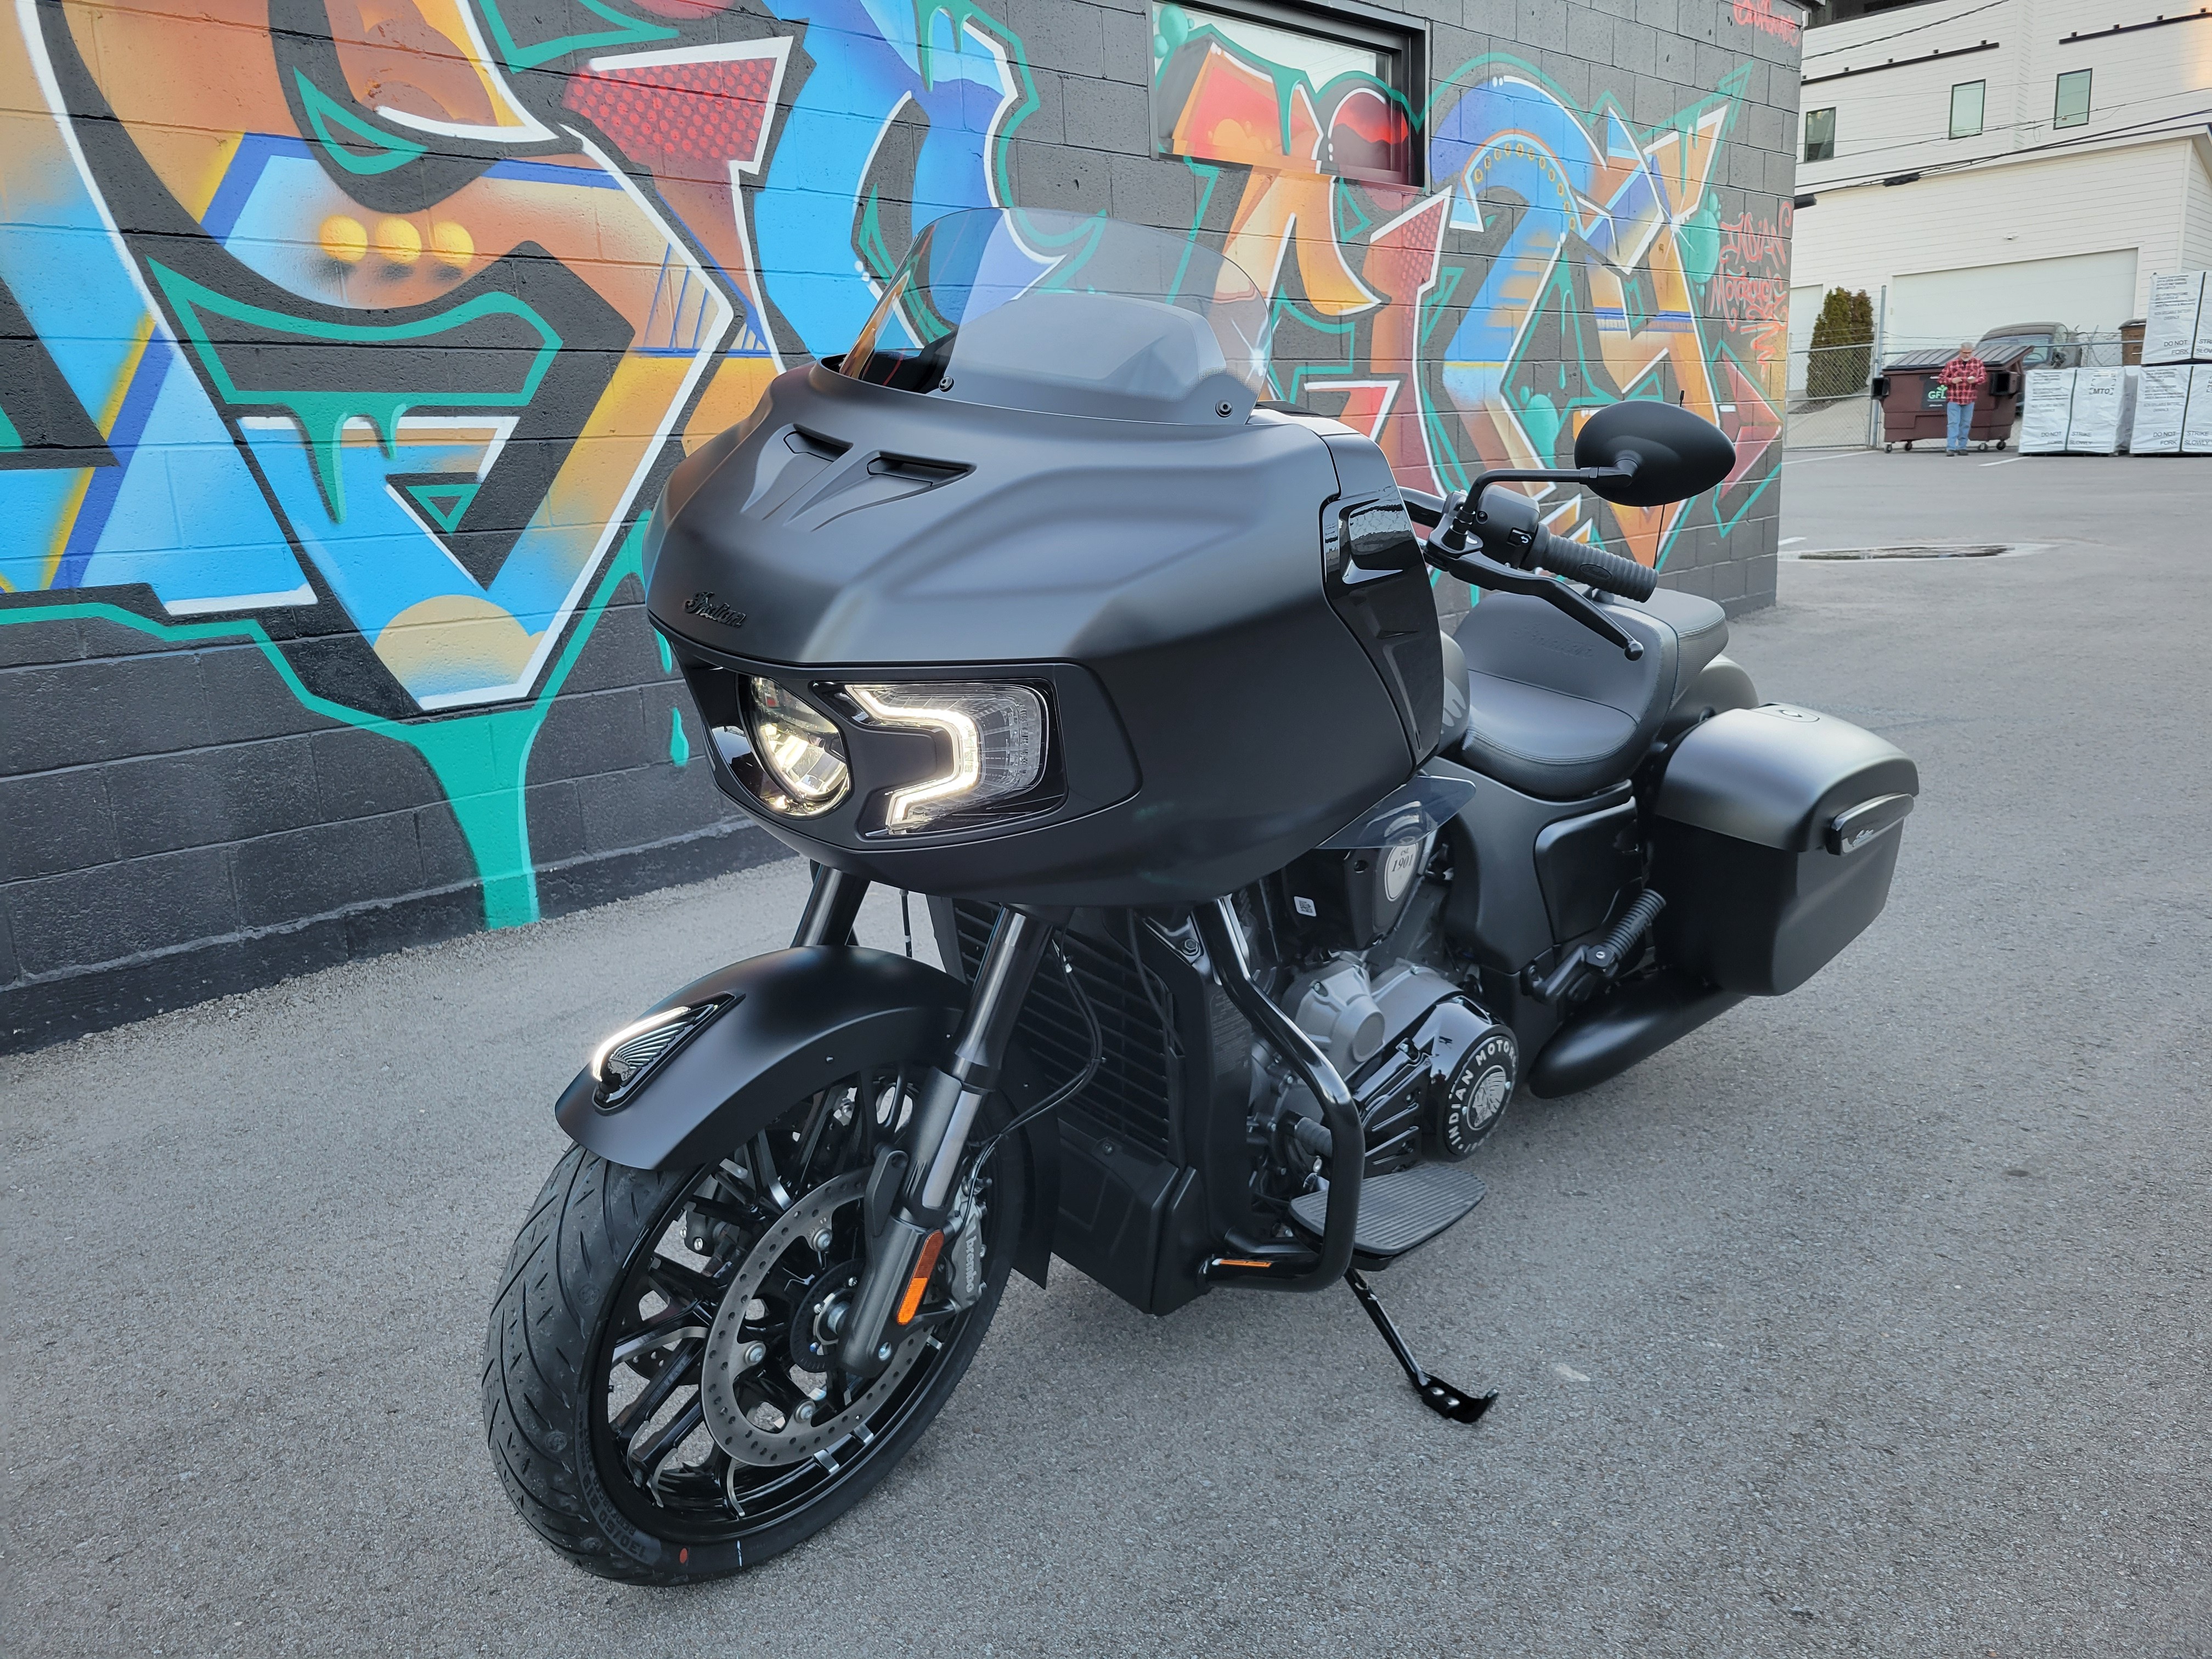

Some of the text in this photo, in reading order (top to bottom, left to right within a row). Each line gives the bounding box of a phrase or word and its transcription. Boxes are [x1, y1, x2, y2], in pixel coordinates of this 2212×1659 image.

[1928, 391, 1947, 399] GFL
[685, 591, 746, 628] Indian
[1391, 854, 1413, 872] 1901
[1448, 1069, 1475, 1146] INDIAN
[966, 1235, 977, 1293] brembo
